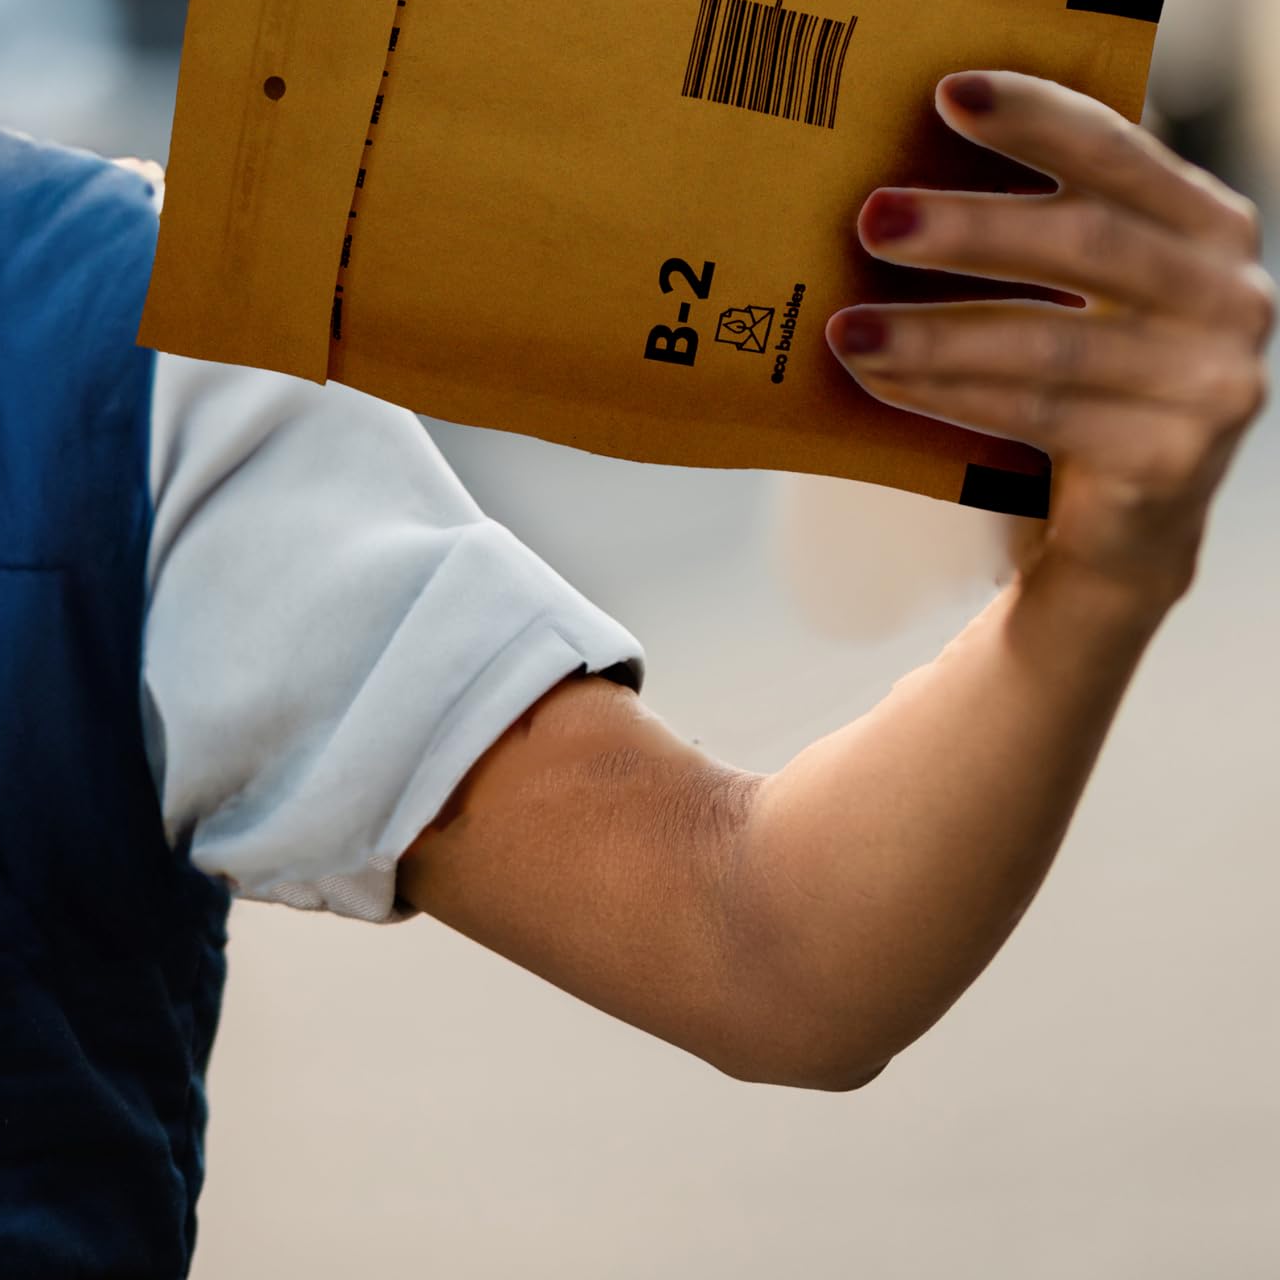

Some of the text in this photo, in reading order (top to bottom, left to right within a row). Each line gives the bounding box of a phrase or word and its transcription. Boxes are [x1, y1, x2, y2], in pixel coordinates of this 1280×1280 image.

[643, 257, 716, 367] B-2
[771, 283, 806, 384] eco bubbles
